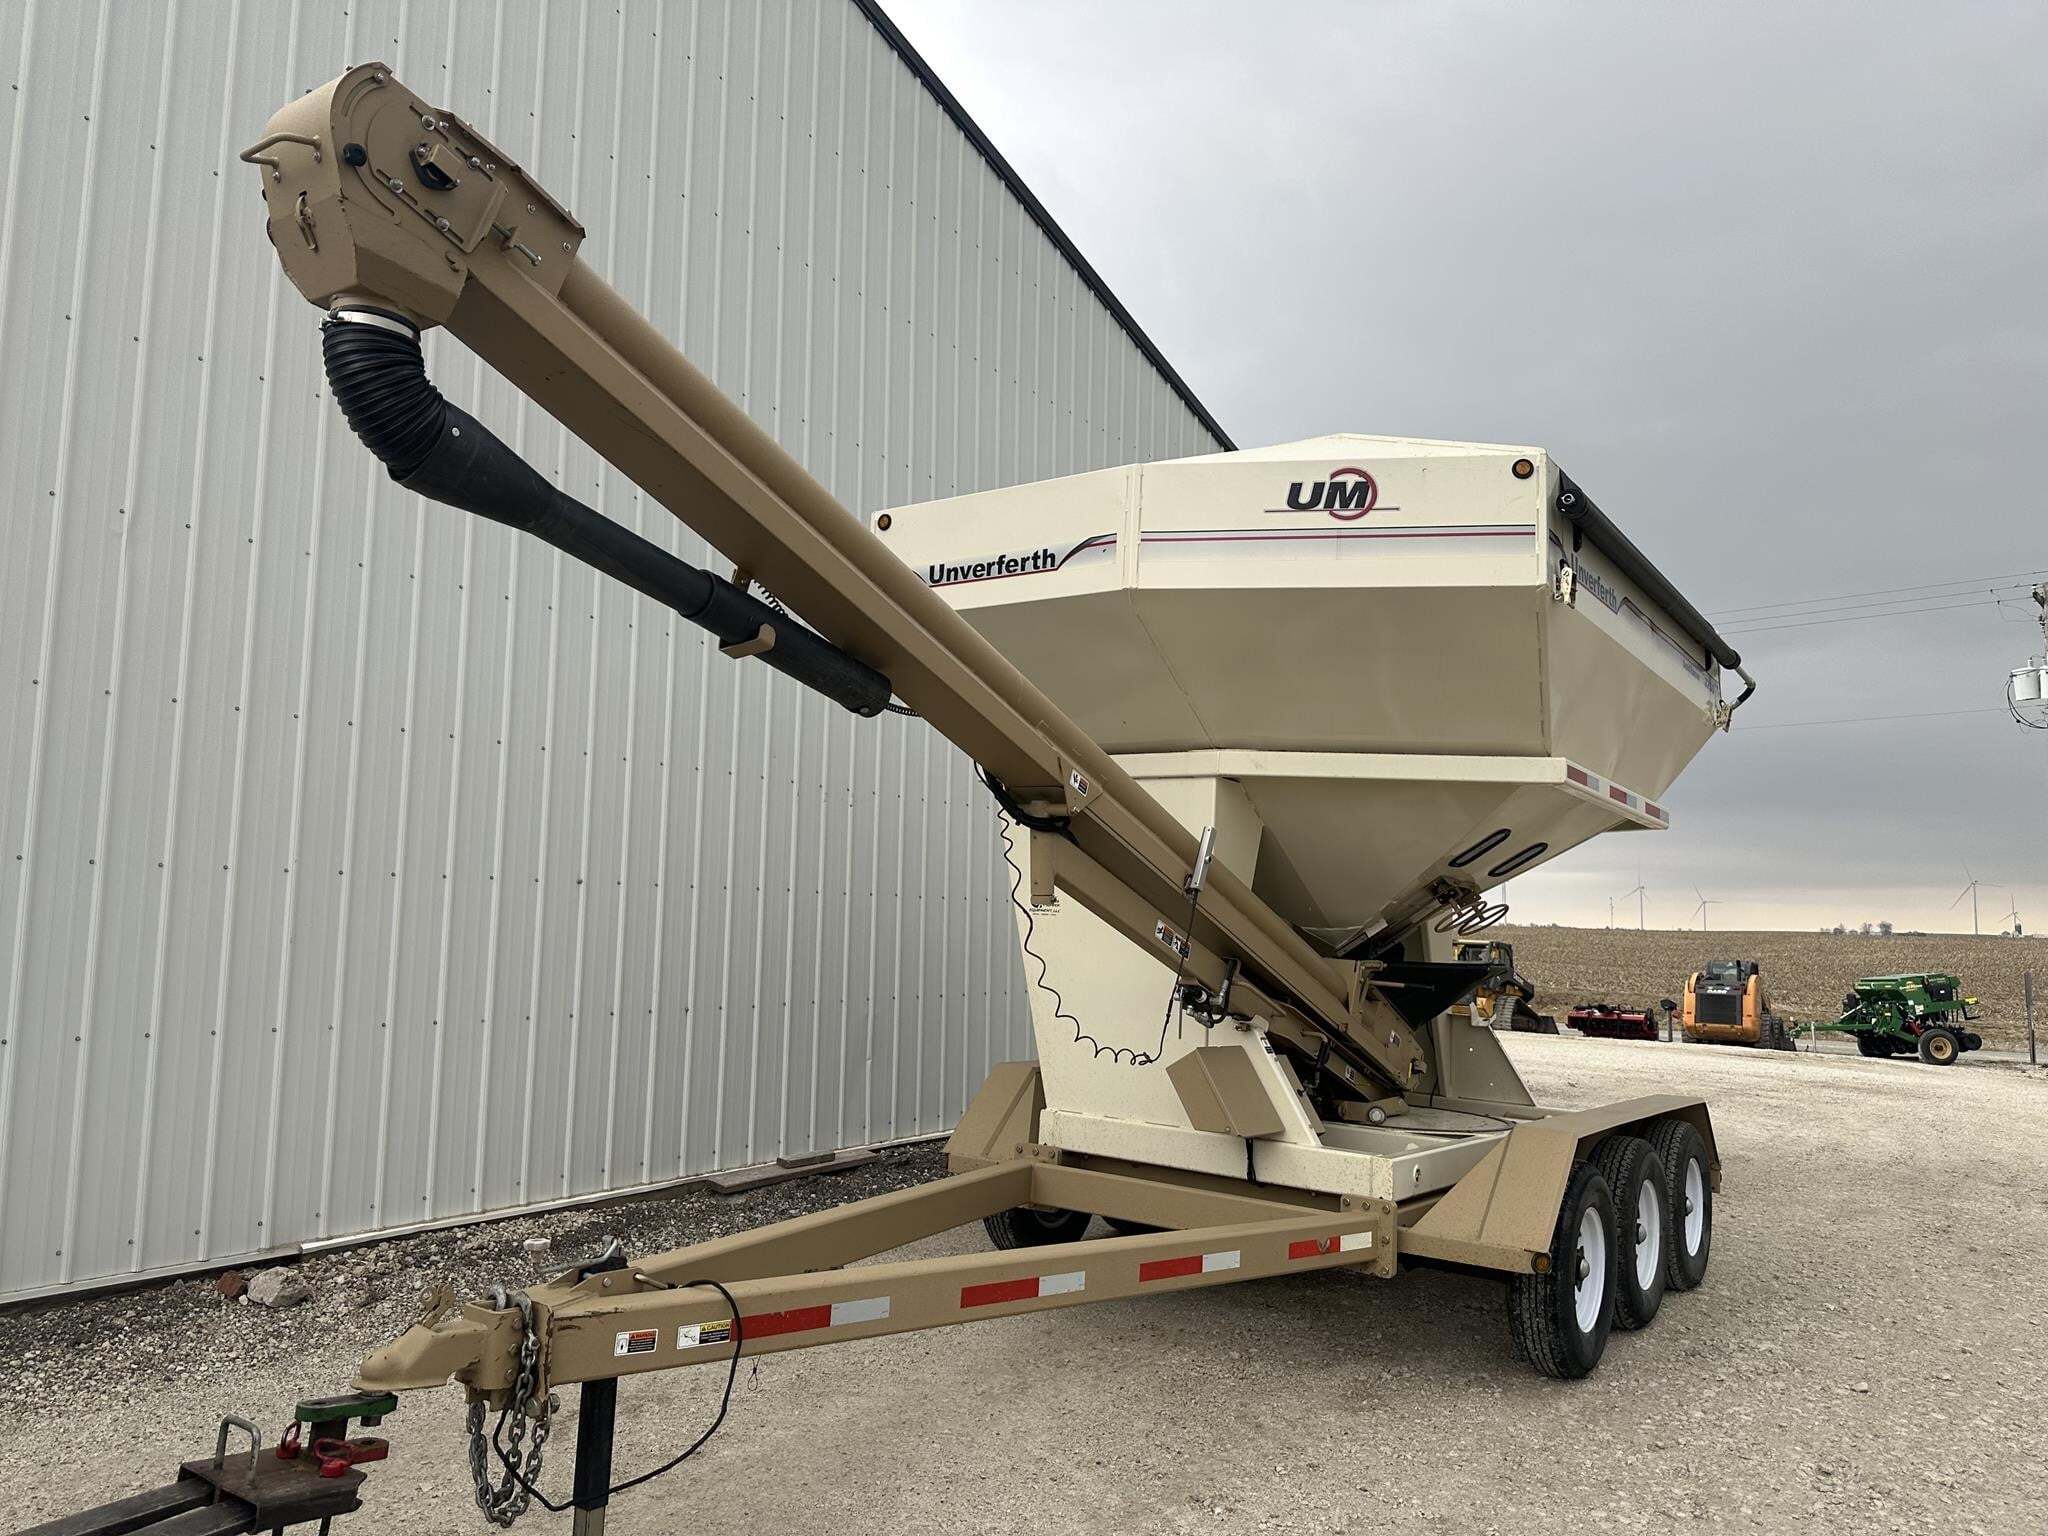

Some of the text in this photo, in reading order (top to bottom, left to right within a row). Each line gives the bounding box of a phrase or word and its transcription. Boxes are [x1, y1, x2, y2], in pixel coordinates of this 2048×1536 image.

[1287, 481, 1370, 510] UM
[929, 548, 1056, 584] Unverferth
[1571, 552, 1618, 609] Unverferth
[706, 1322, 730, 1331] CAUTION
